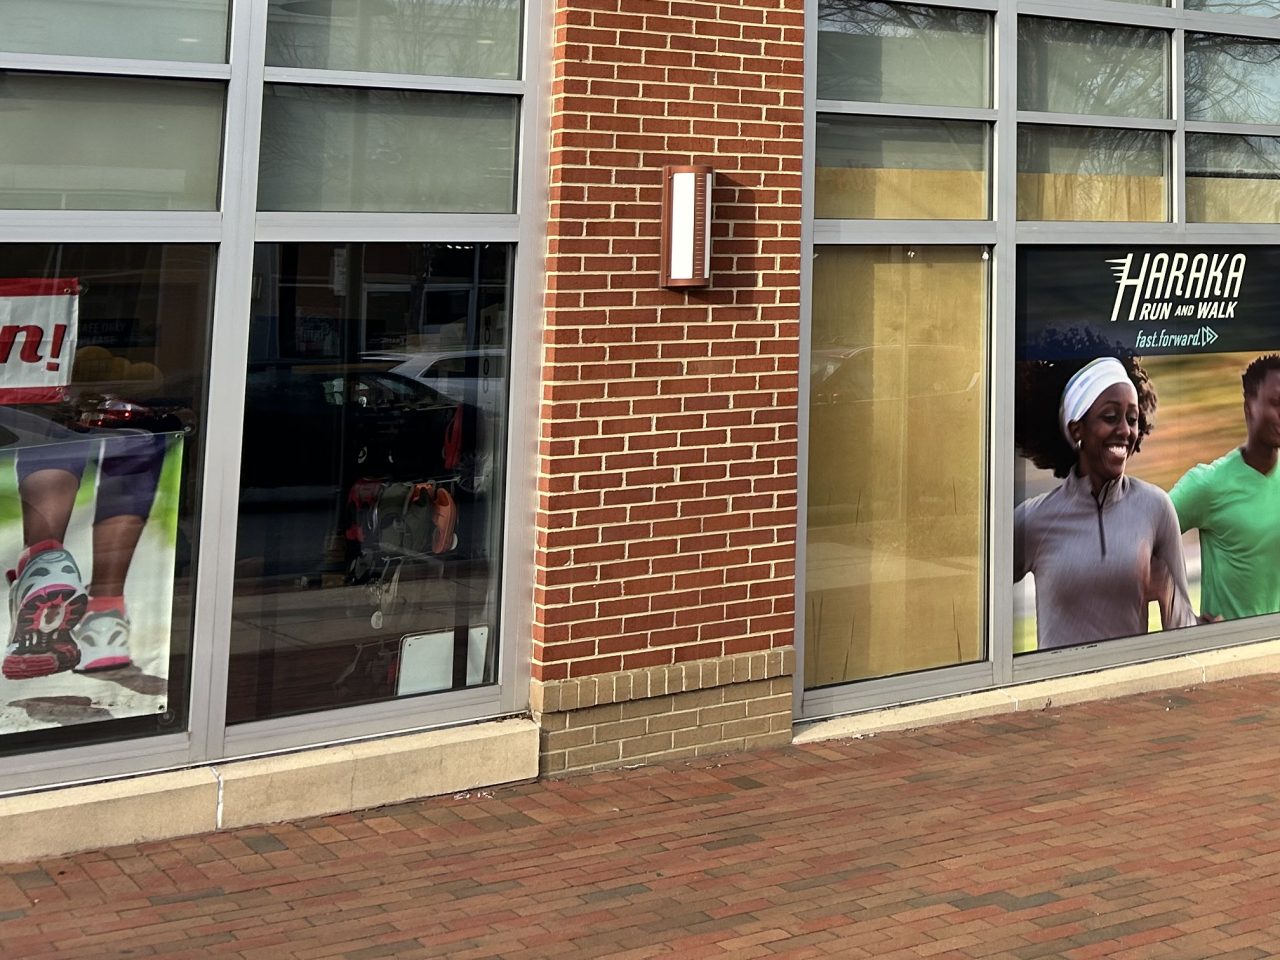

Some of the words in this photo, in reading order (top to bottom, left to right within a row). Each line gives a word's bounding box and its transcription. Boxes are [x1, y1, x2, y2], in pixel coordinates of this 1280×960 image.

[1105, 253, 1246, 321] HARAKA
[1139, 302, 1173, 321] RUN
[1174, 304, 1195, 317] AND
[1197, 301, 1239, 319] WALK
